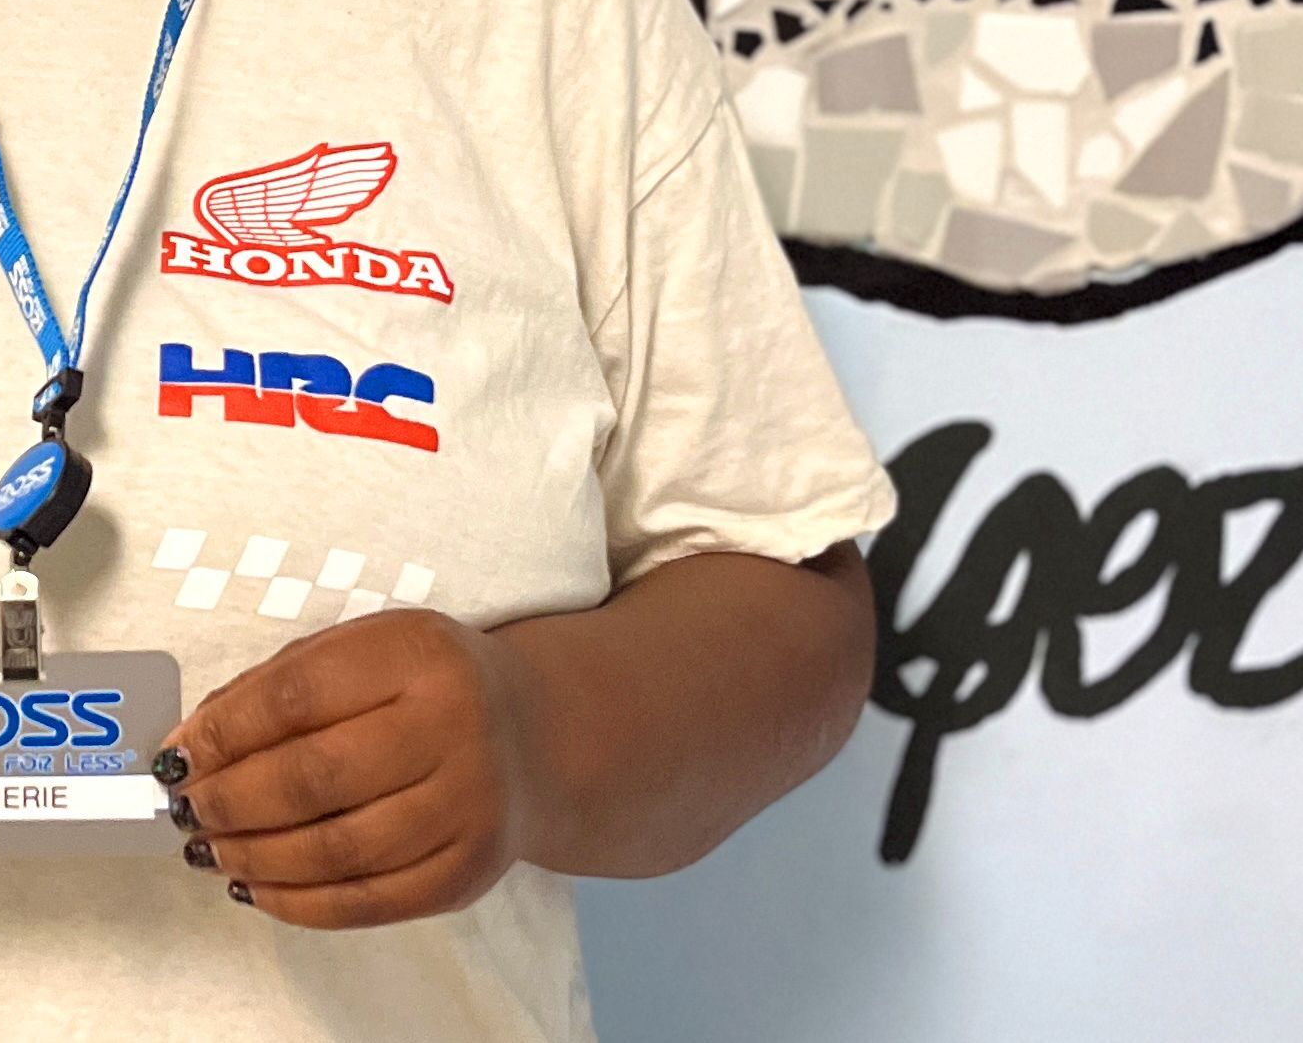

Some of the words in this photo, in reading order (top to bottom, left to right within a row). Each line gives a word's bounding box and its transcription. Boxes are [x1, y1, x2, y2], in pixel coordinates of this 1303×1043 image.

[8, 260, 44, 334] ROSS
[168, 236, 451, 296] HONDA
[159, 343, 439, 453] HRC
[4, 755, 53, 775] FOR
